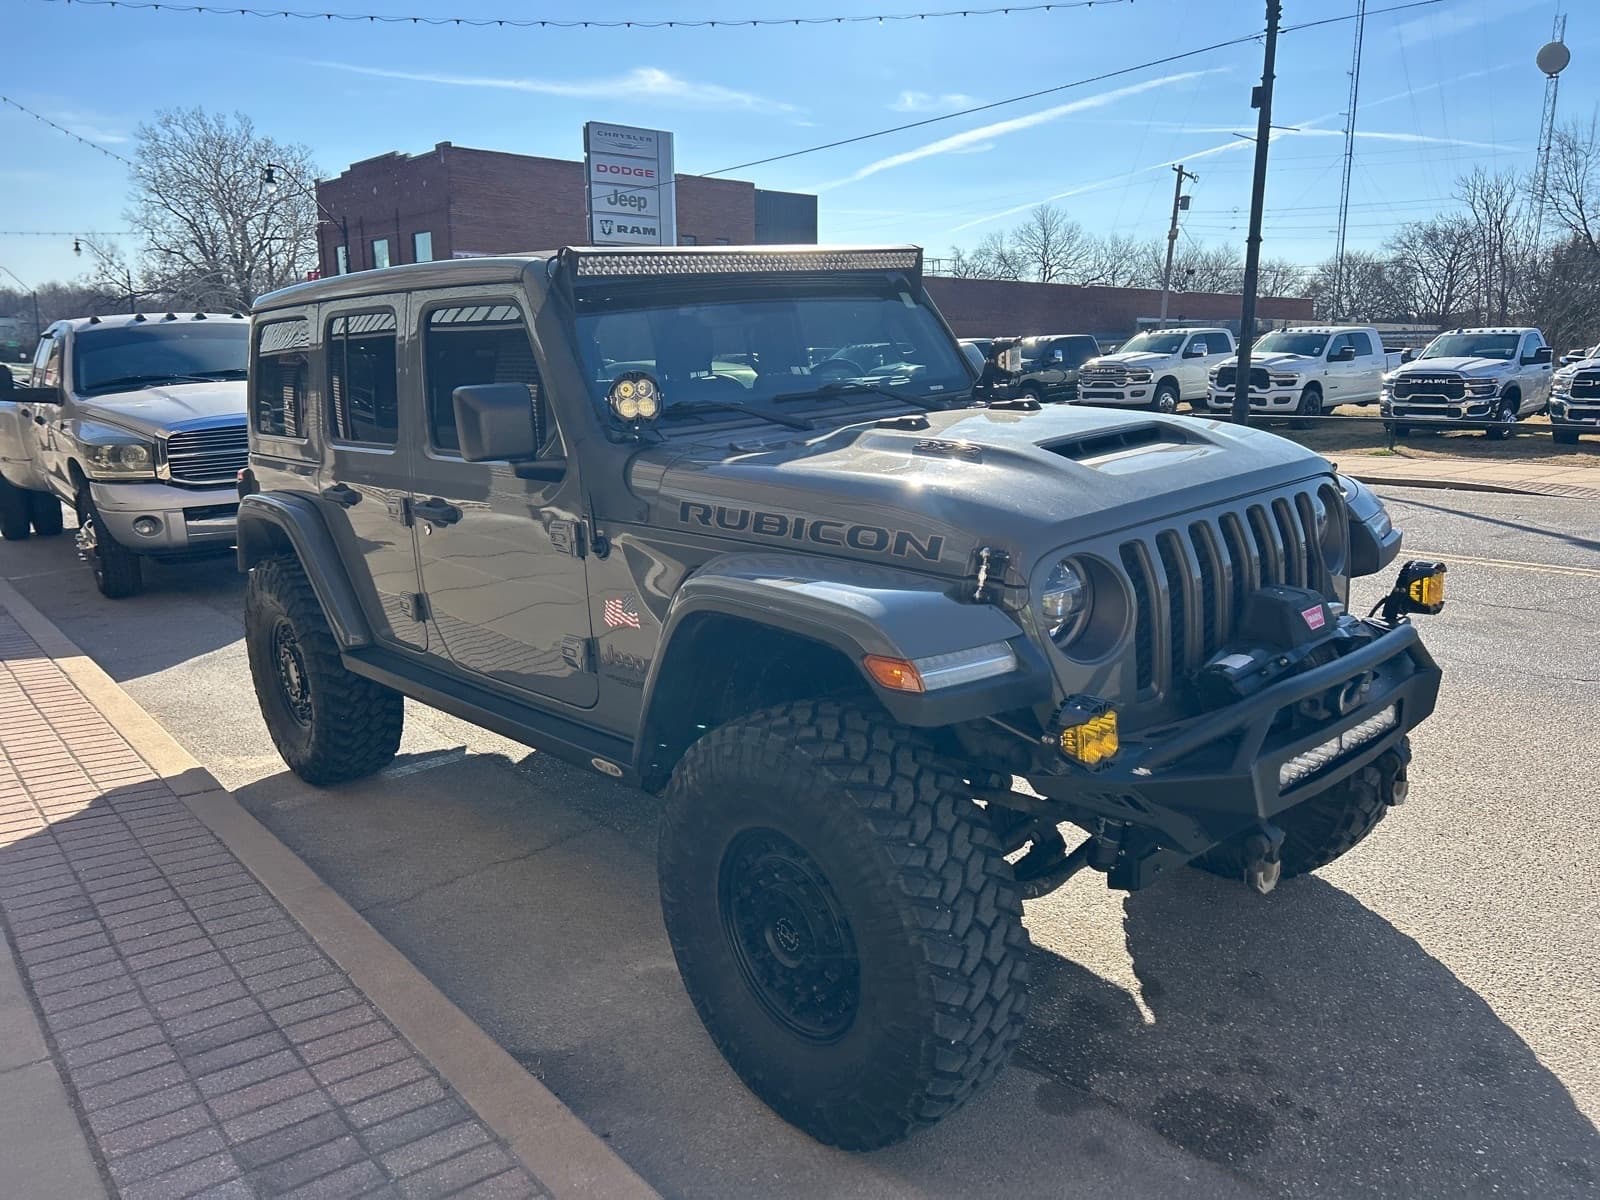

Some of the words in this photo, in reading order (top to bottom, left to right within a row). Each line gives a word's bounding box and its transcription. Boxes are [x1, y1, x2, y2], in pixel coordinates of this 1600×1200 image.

[597, 130, 652, 142] CHRYSLER
[596, 164, 655, 178] DODGE
[607, 189, 648, 212] Jeep
[616, 224, 657, 237] RAM
[679, 501, 945, 562] RUBICON
